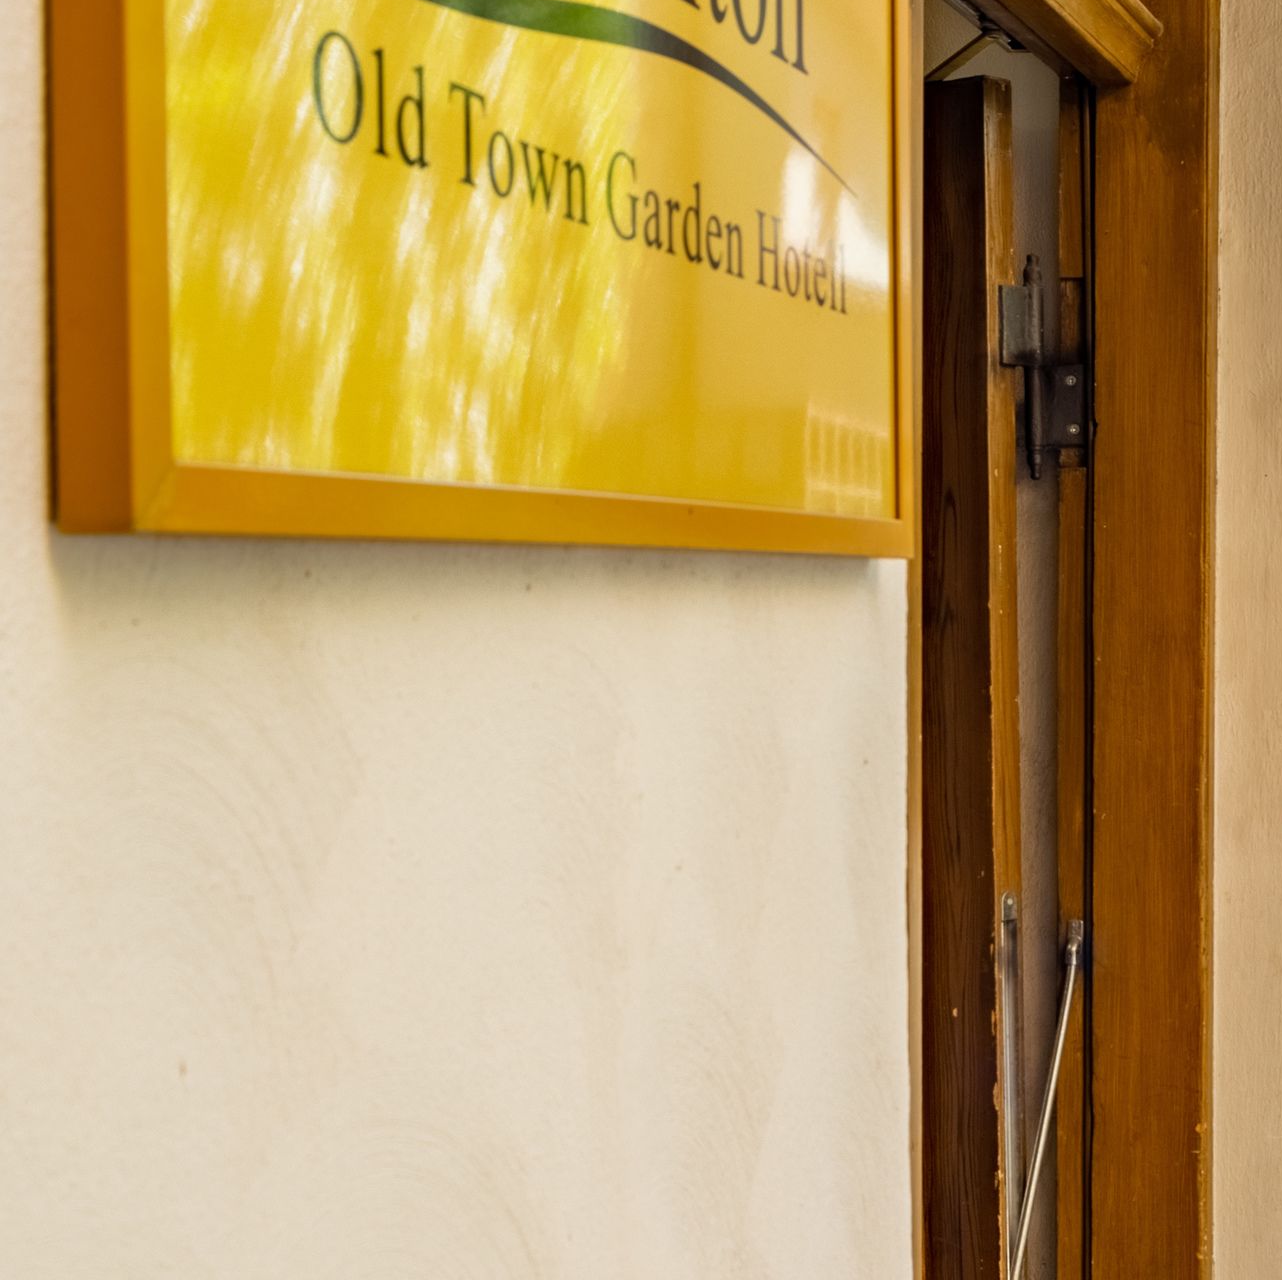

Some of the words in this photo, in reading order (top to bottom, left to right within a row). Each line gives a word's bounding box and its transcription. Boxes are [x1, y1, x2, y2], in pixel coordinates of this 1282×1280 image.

[312, 31, 429, 169] Old
[450, 80, 588, 226] Town
[606, 150, 744, 280] Garden
[756, 209, 847, 315] Hotell
